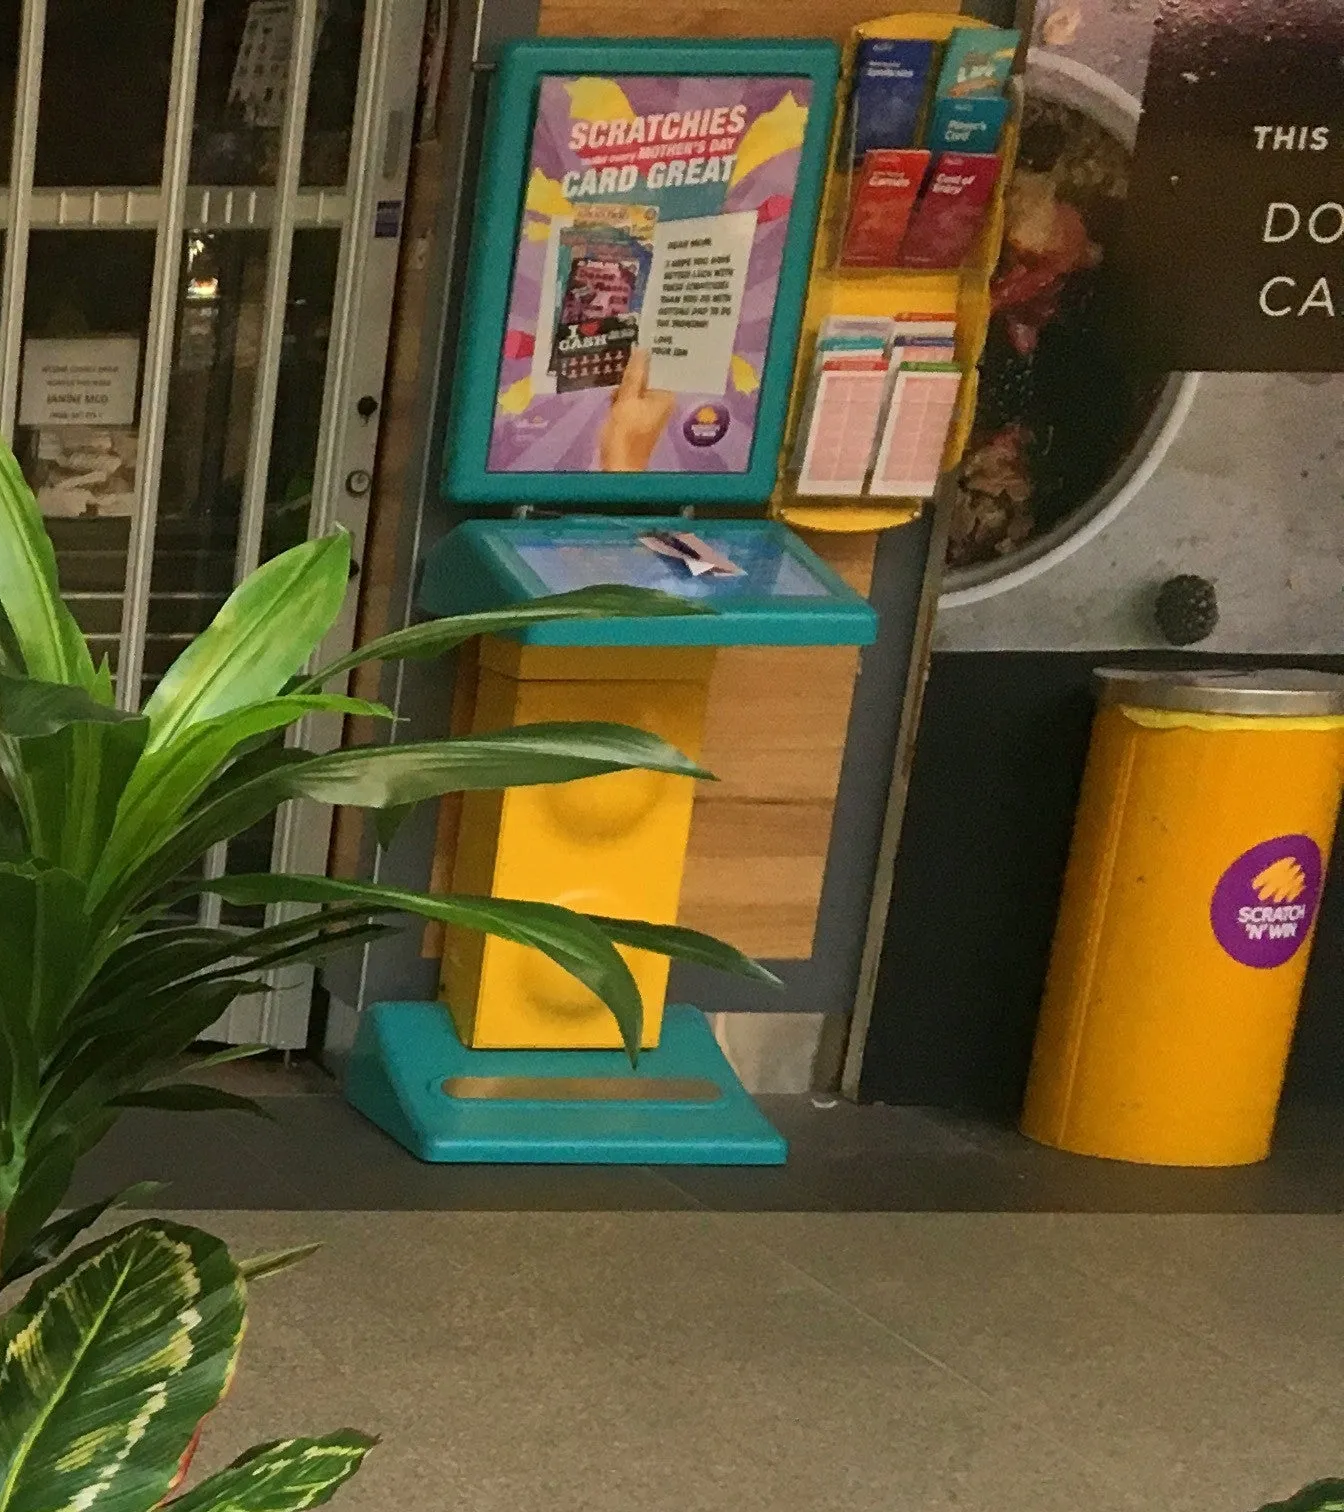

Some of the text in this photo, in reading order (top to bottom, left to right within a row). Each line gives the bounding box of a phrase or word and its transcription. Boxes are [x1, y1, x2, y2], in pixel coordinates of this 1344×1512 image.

[568, 104, 748, 151] SCRATCHIES
[1253, 125, 1330, 150] THIS
[709, 137, 737, 152] DAY
[562, 153, 739, 199] CARD GREAT
[1263, 202, 1344, 243] DO
[1259, 276, 1335, 317] CA
[1237, 904, 1306, 923] SCRATCH
[1269, 922, 1298, 940] WIN
